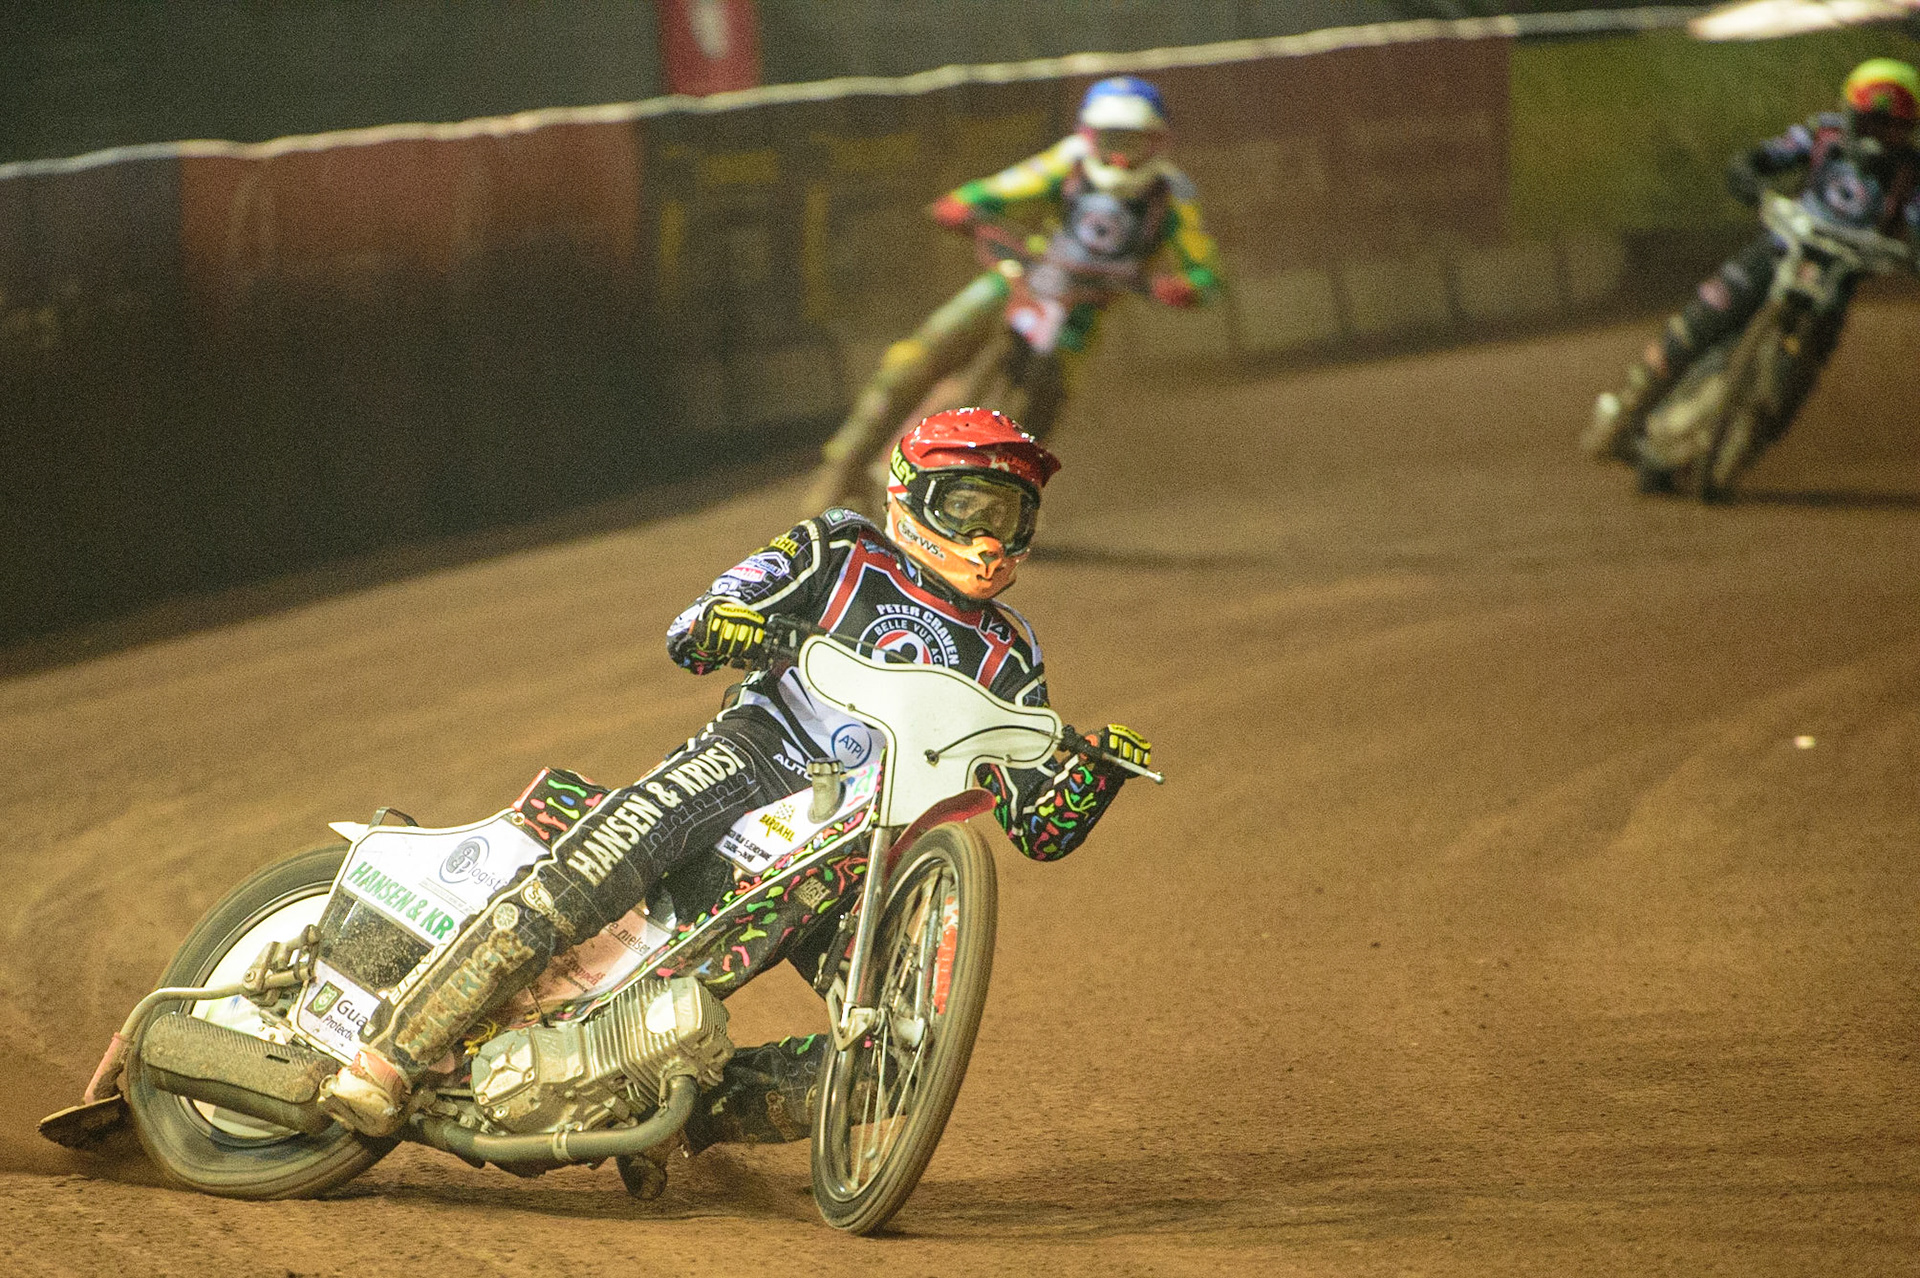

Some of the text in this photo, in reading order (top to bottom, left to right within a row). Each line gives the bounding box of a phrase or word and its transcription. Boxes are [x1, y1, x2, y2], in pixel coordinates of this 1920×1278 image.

[874, 619, 908, 637] BELLE
[913, 624, 935, 645] VUE
[876, 604, 960, 666] PETER CRAVEN
[979, 610, 1011, 644] 14
[838, 734, 865, 760] ATPI
[567, 793, 664, 887] HANSEN
[645, 781, 682, 808] &
[759, 813, 796, 843] BARDAHL
[347, 861, 418, 913] HANSEN
[405, 899, 429, 921] &
[337, 1000, 368, 1027] Gua
